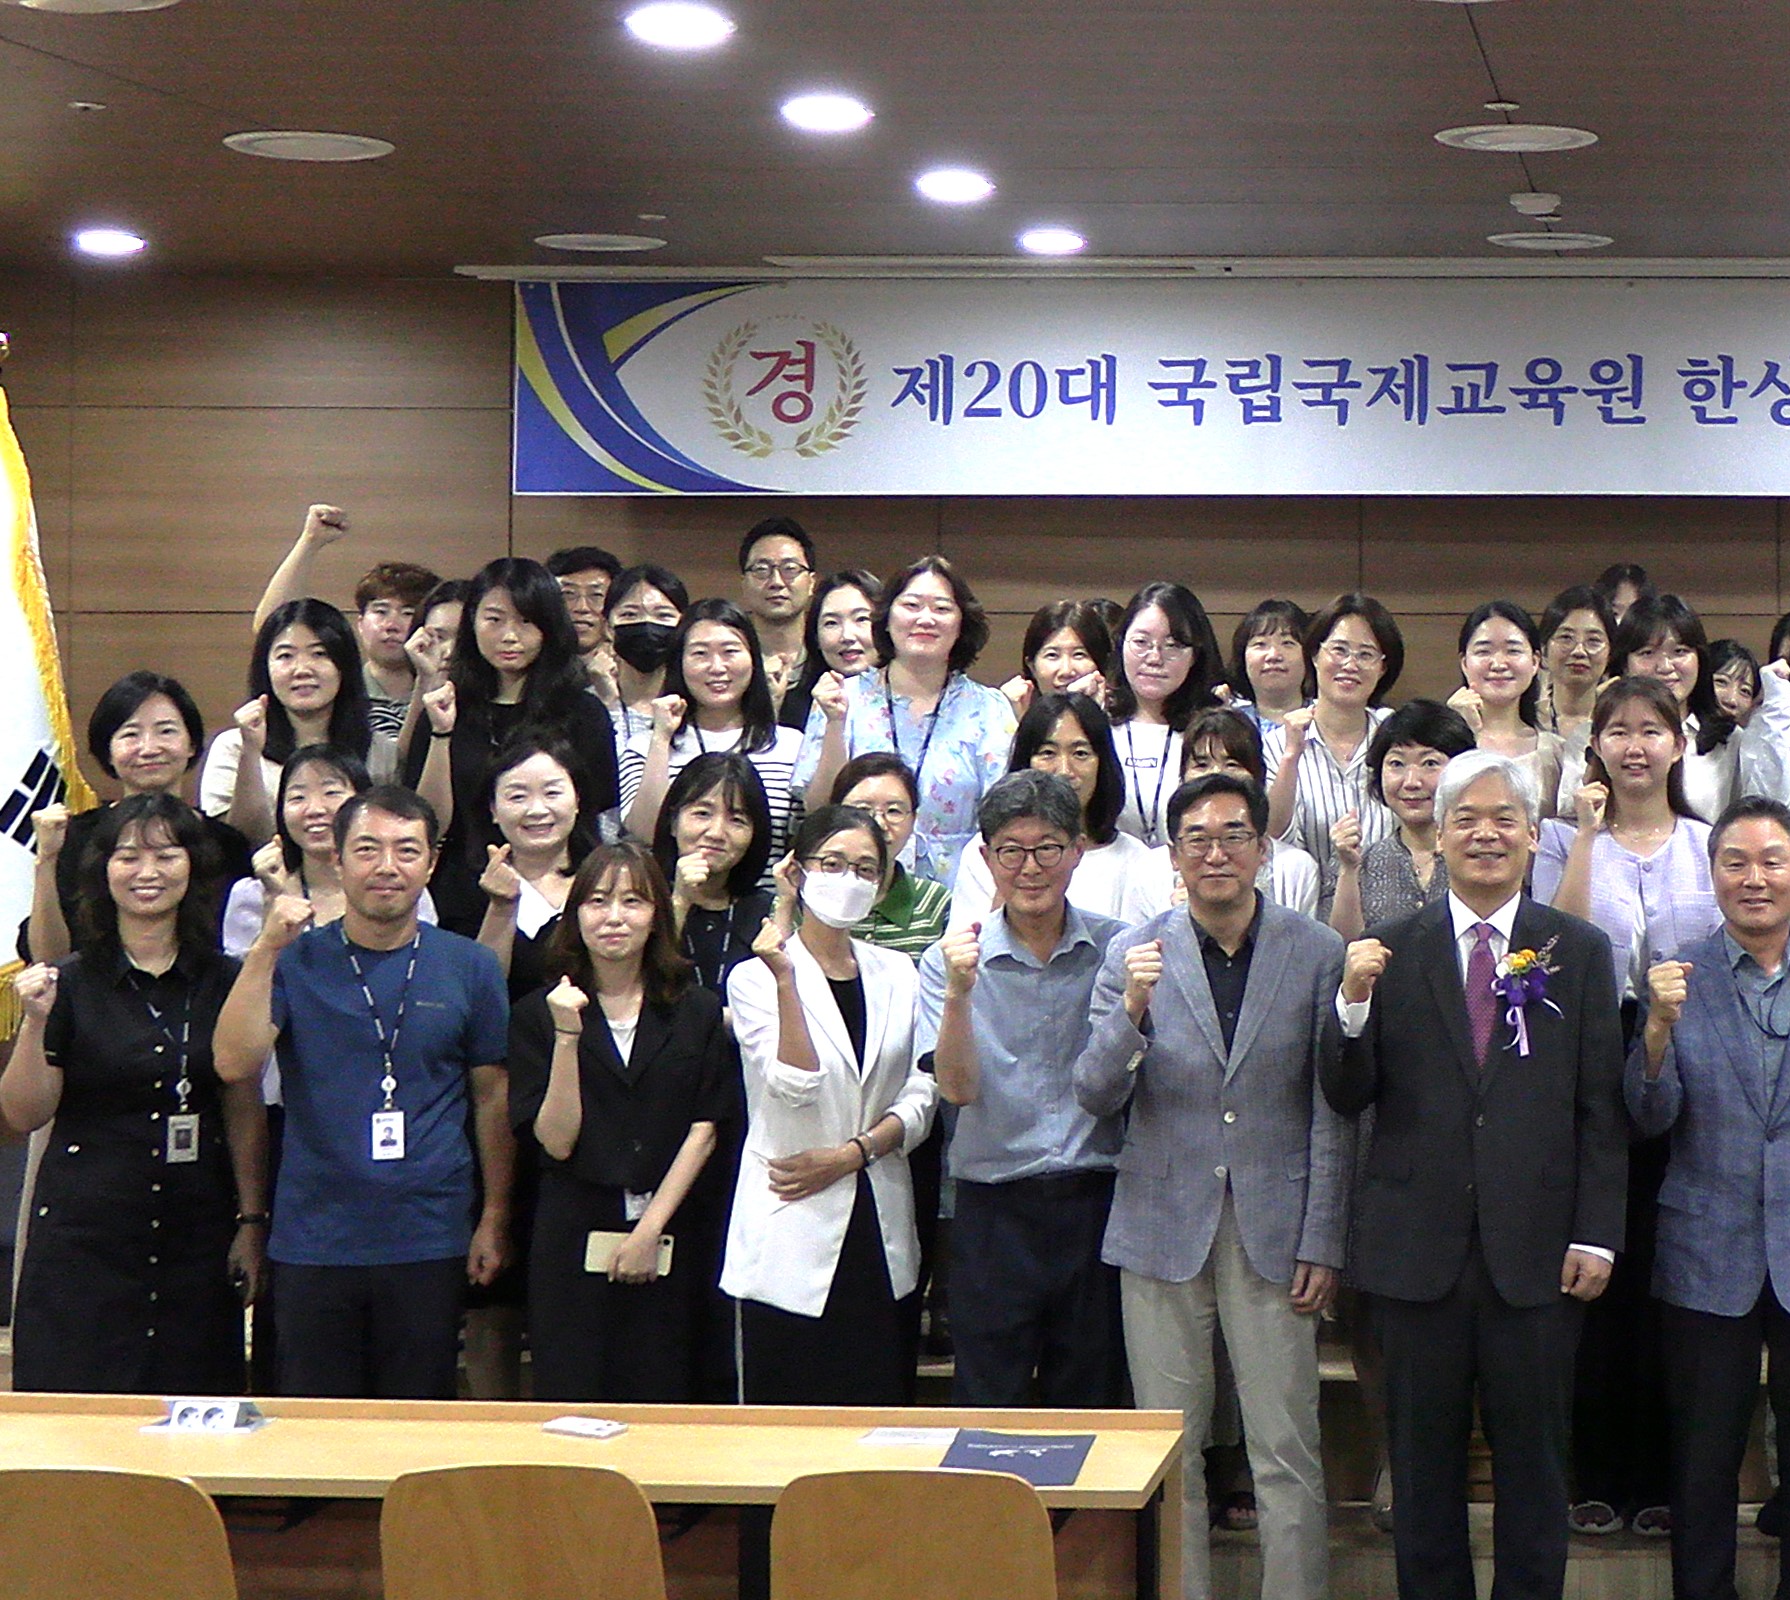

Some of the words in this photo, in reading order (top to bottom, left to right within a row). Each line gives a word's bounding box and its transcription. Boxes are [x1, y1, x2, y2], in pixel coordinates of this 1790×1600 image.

[745, 339, 816, 425] 경
[890, 354, 1118, 428] 제20대
[1147, 354, 1648, 428] 국립국제교육원
